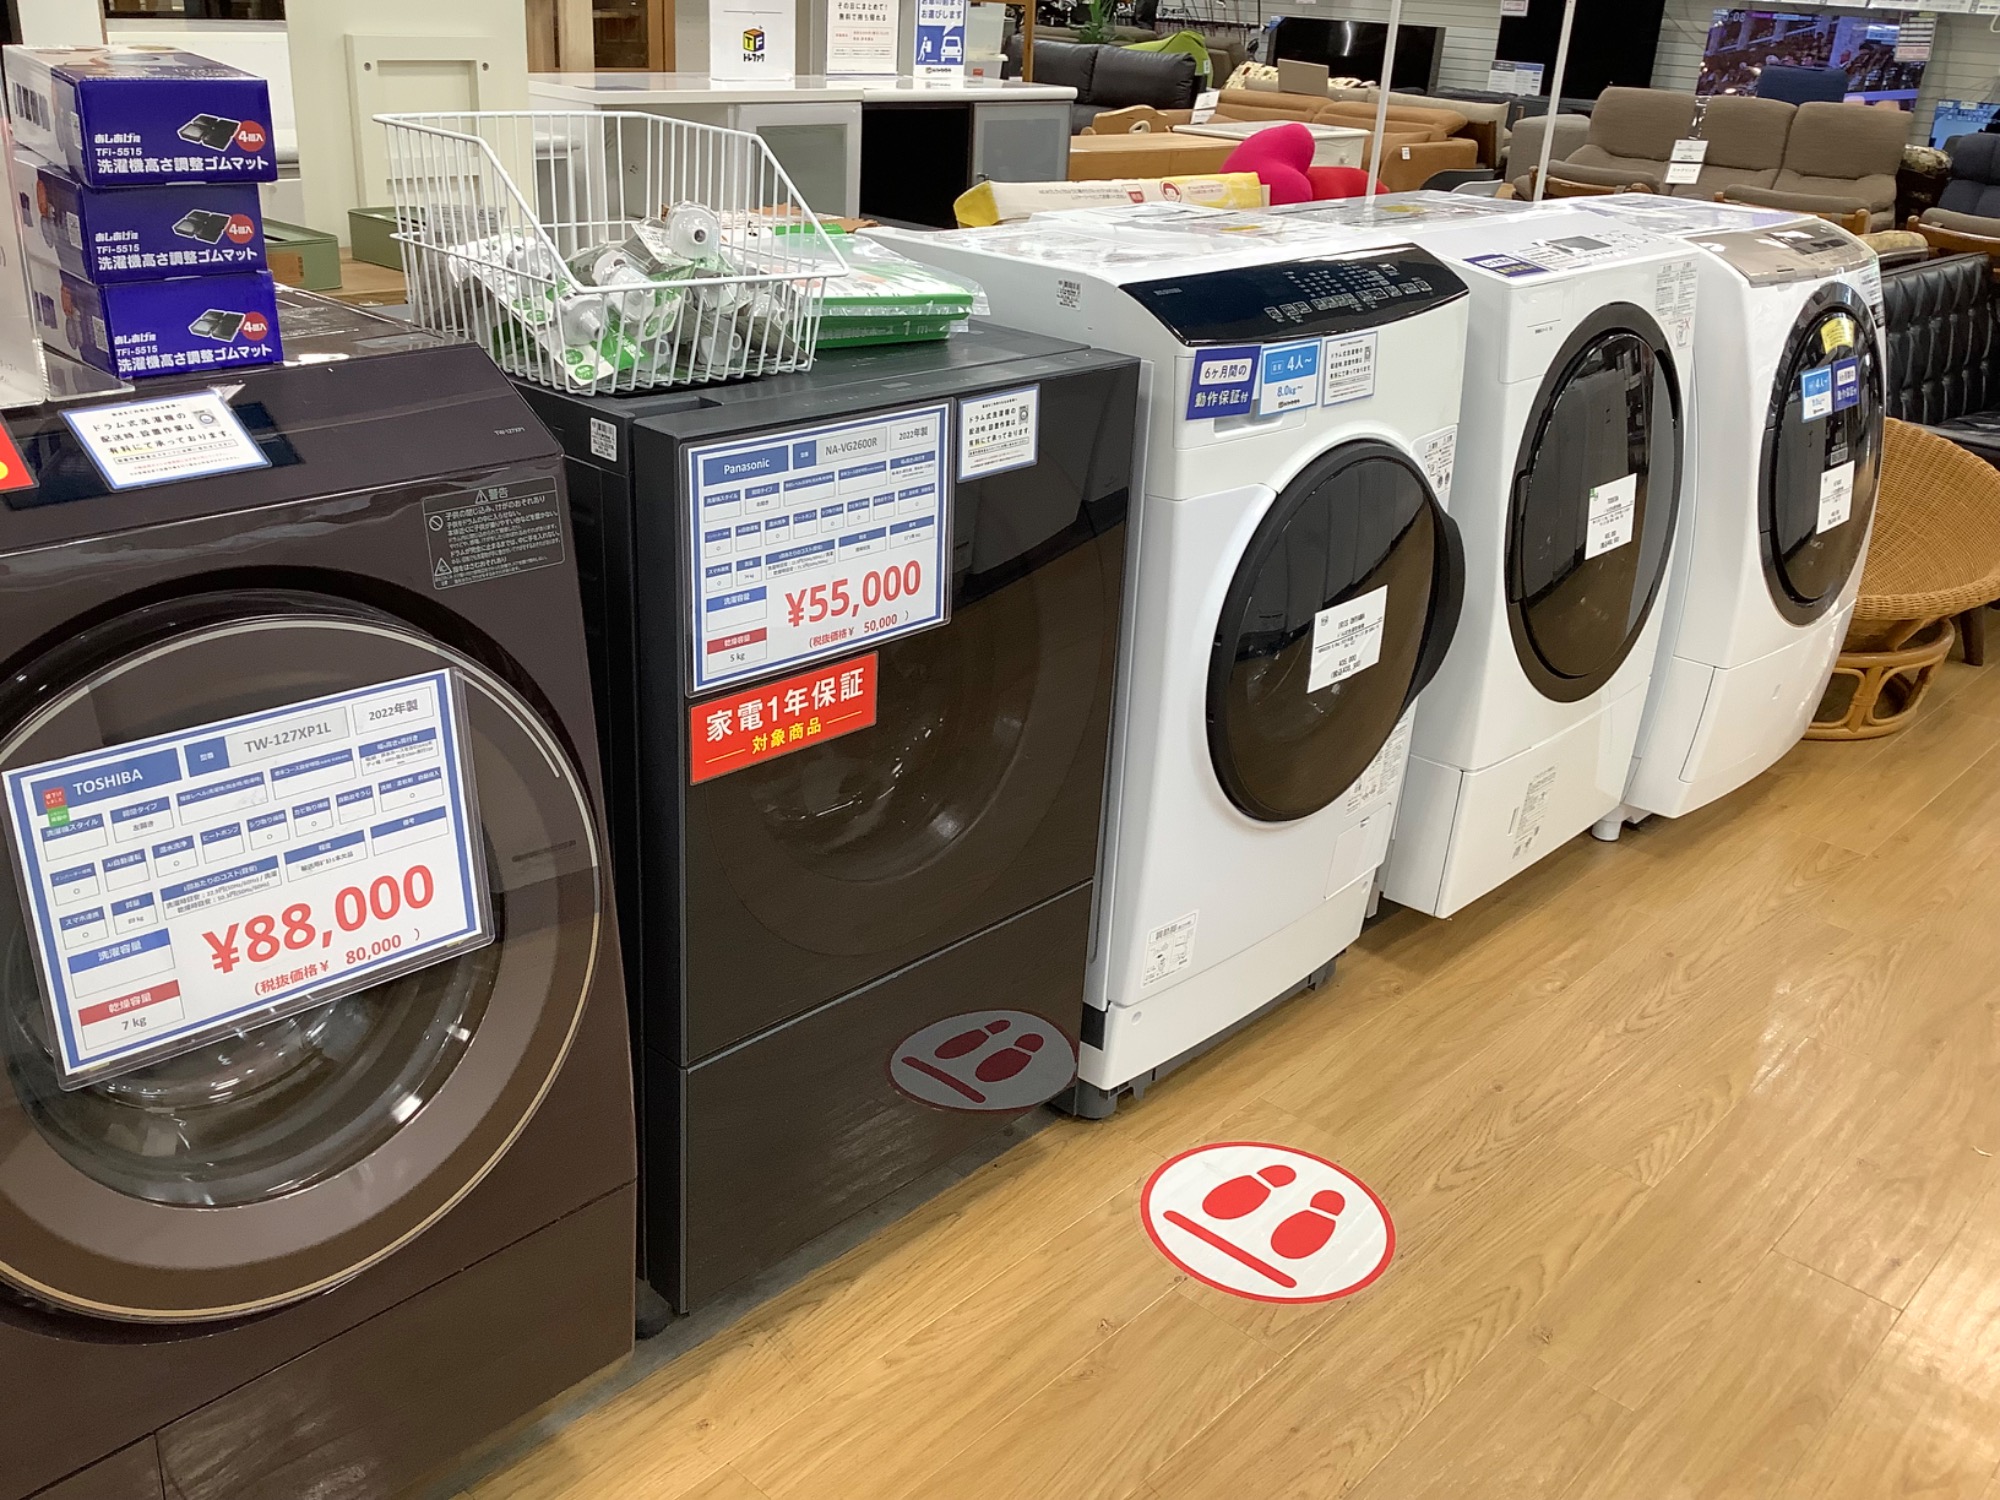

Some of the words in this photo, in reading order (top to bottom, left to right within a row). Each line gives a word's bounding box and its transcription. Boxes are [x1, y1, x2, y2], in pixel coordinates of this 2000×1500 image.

[97, 156, 269, 173] 洗濯機高さ調整ゴムマット
[98, 248, 257, 270] 洗濯機高さ調整ゴムマット
[117, 344, 272, 372] 洗濯機高さ調整ゴムマット
[1204, 364, 1247, 379] 6ヶ月間の
[1195, 388, 1248, 408] 動作保証付
[93, 412, 187, 433] ドラム式洗濯機の
[825, 437, 877, 455] NA-VG2600R
[724, 457, 770, 475] Panasonic
[784, 560, 921, 628] ¥55,000
[863, 614, 898, 633] 50,000
[369, 699, 418, 721] 2022年製
[706, 667, 864, 743] 家電1年保証
[244, 719, 332, 753] TW-127XP1L
[751, 716, 822, 755] 対象商品
[73, 768, 143, 796] TOSHIBA
[202, 864, 434, 974] ¥88,000
[98, 940, 143, 961] 洗濯容量
[345, 934, 402, 964] 80,000
[121, 1019, 129, 1031] 7
[132, 1016, 147, 1030] kg
